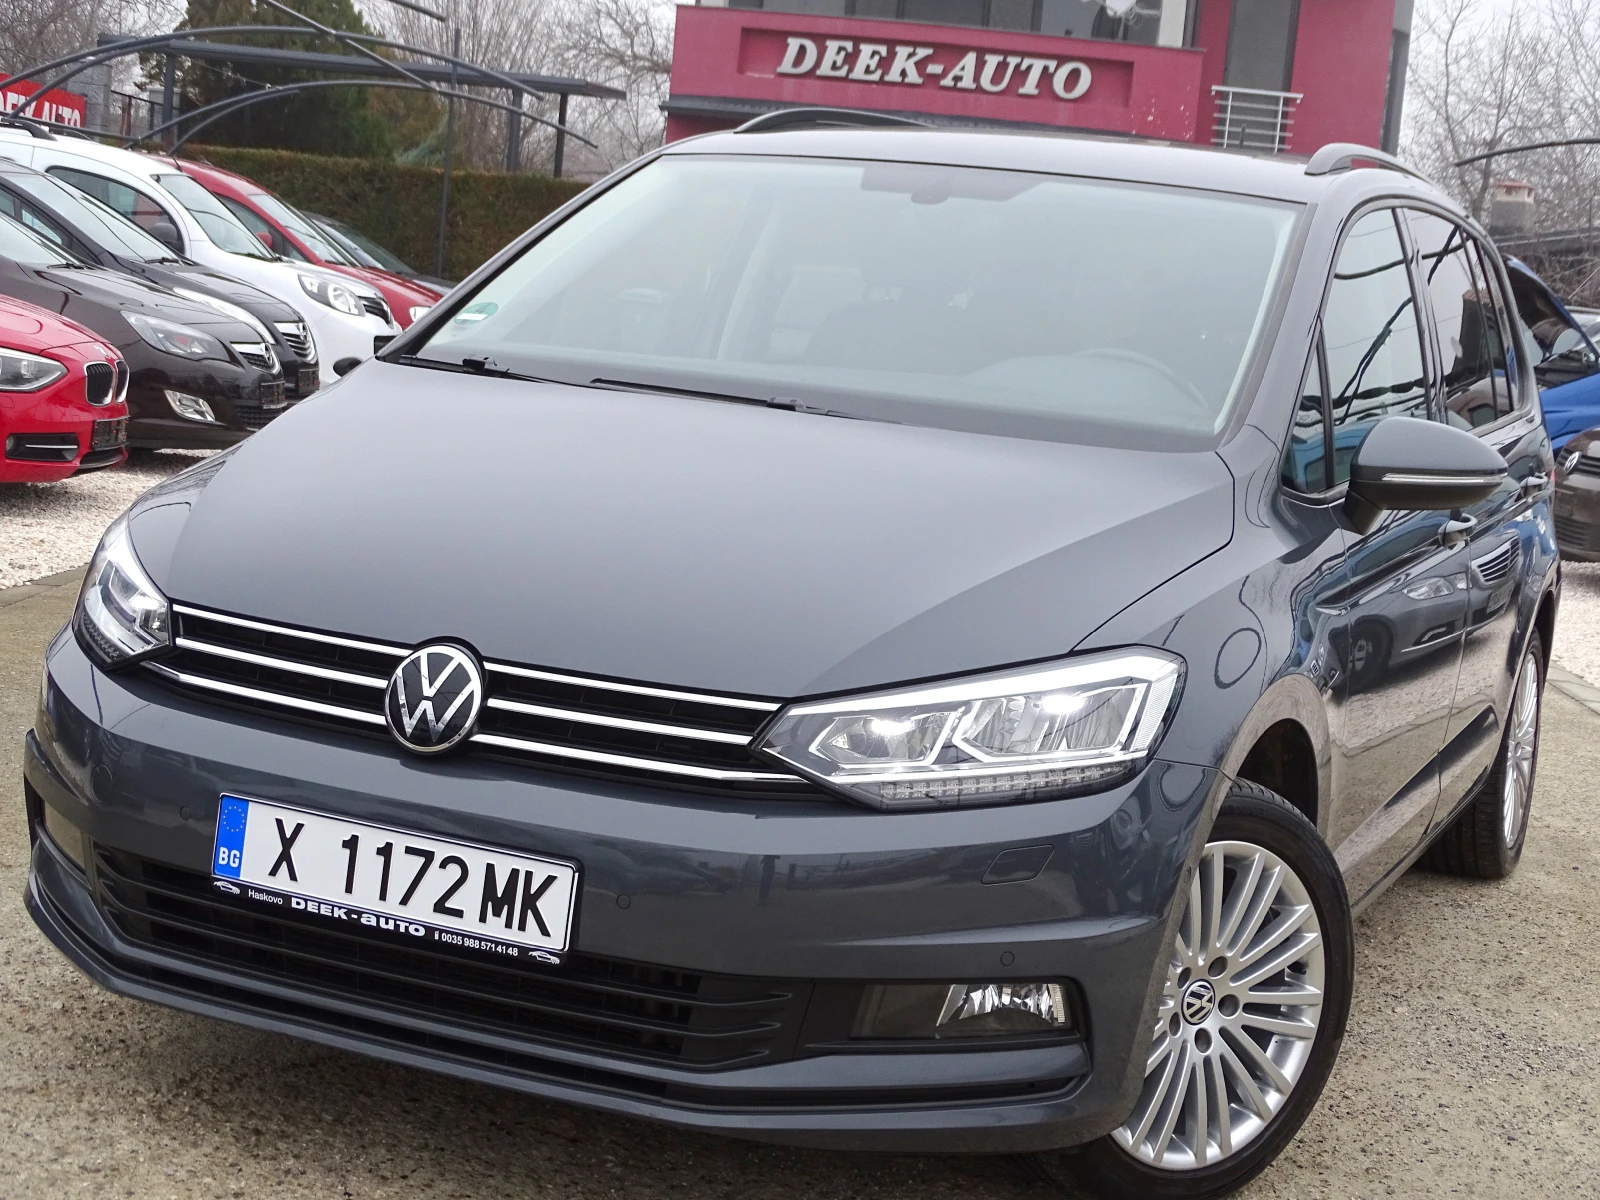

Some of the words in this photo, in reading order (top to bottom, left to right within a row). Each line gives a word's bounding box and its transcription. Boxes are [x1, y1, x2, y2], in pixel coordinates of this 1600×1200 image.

[776, 36, 1092, 100] DEEK-AUTO
[218, 845, 240, 868] BG
[267, 816, 305, 883] X
[341, 833, 470, 919] 1172
[478, 861, 558, 938] MK
[248, 888, 283, 905] Haskovo
[441, 932, 463, 945] 0035
